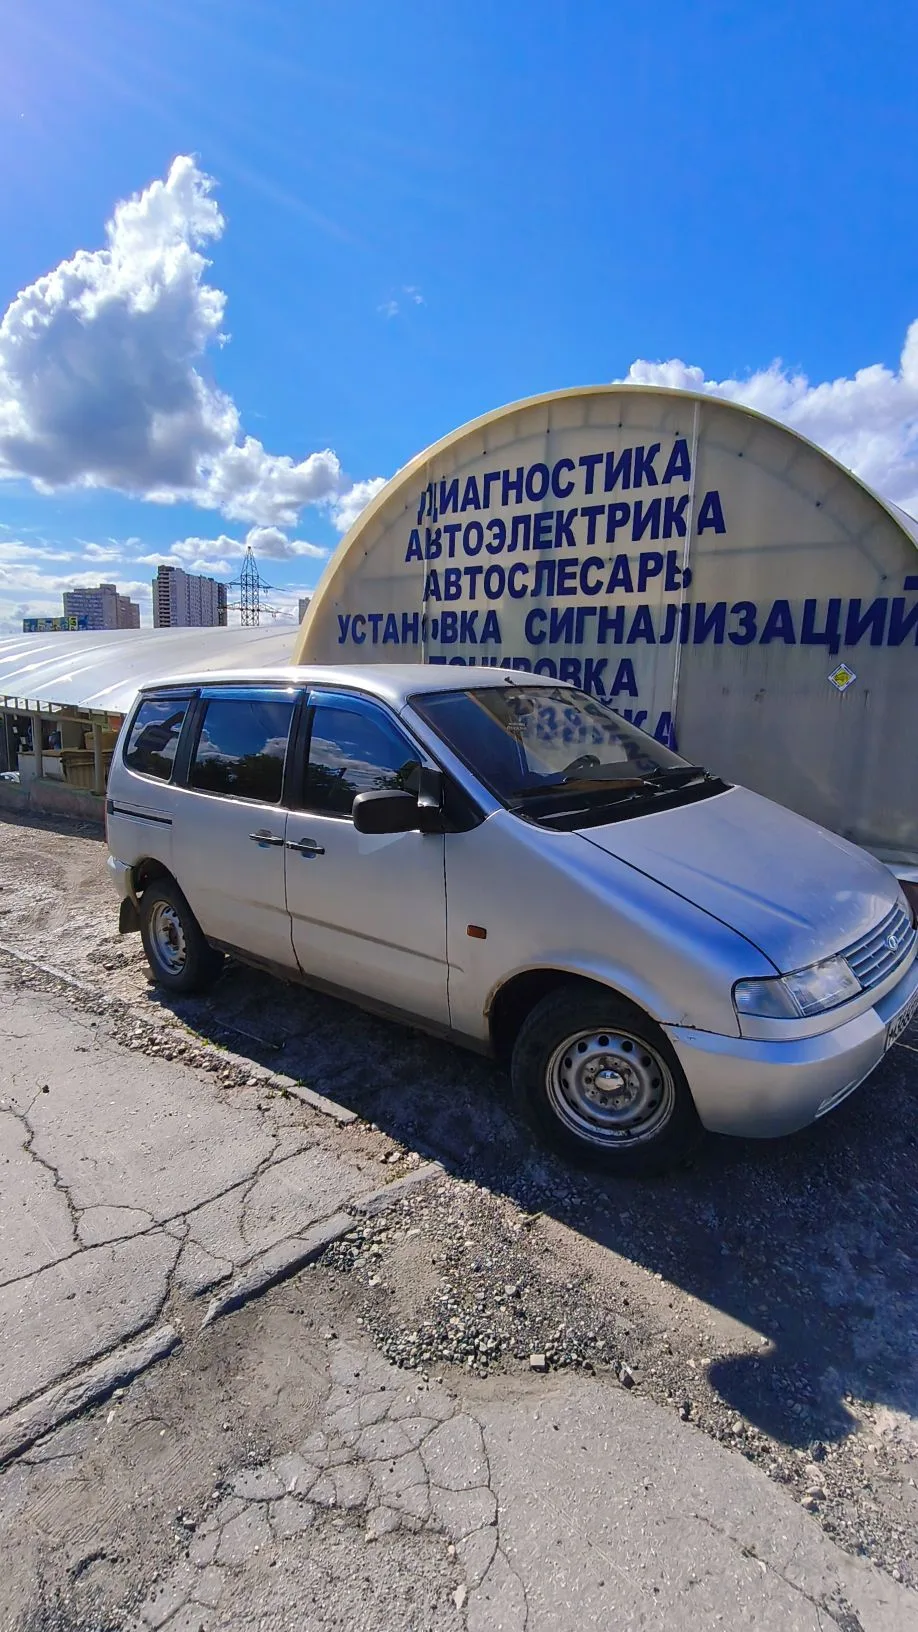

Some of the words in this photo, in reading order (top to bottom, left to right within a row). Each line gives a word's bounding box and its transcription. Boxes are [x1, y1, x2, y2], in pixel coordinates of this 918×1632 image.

[417, 438, 692, 526] ДИАГНОСТИКА
[405, 490, 727, 562] АВТОЭЛЕКТРИКА
[423, 550, 692, 602] АВТОСЛЕСАРЬ
